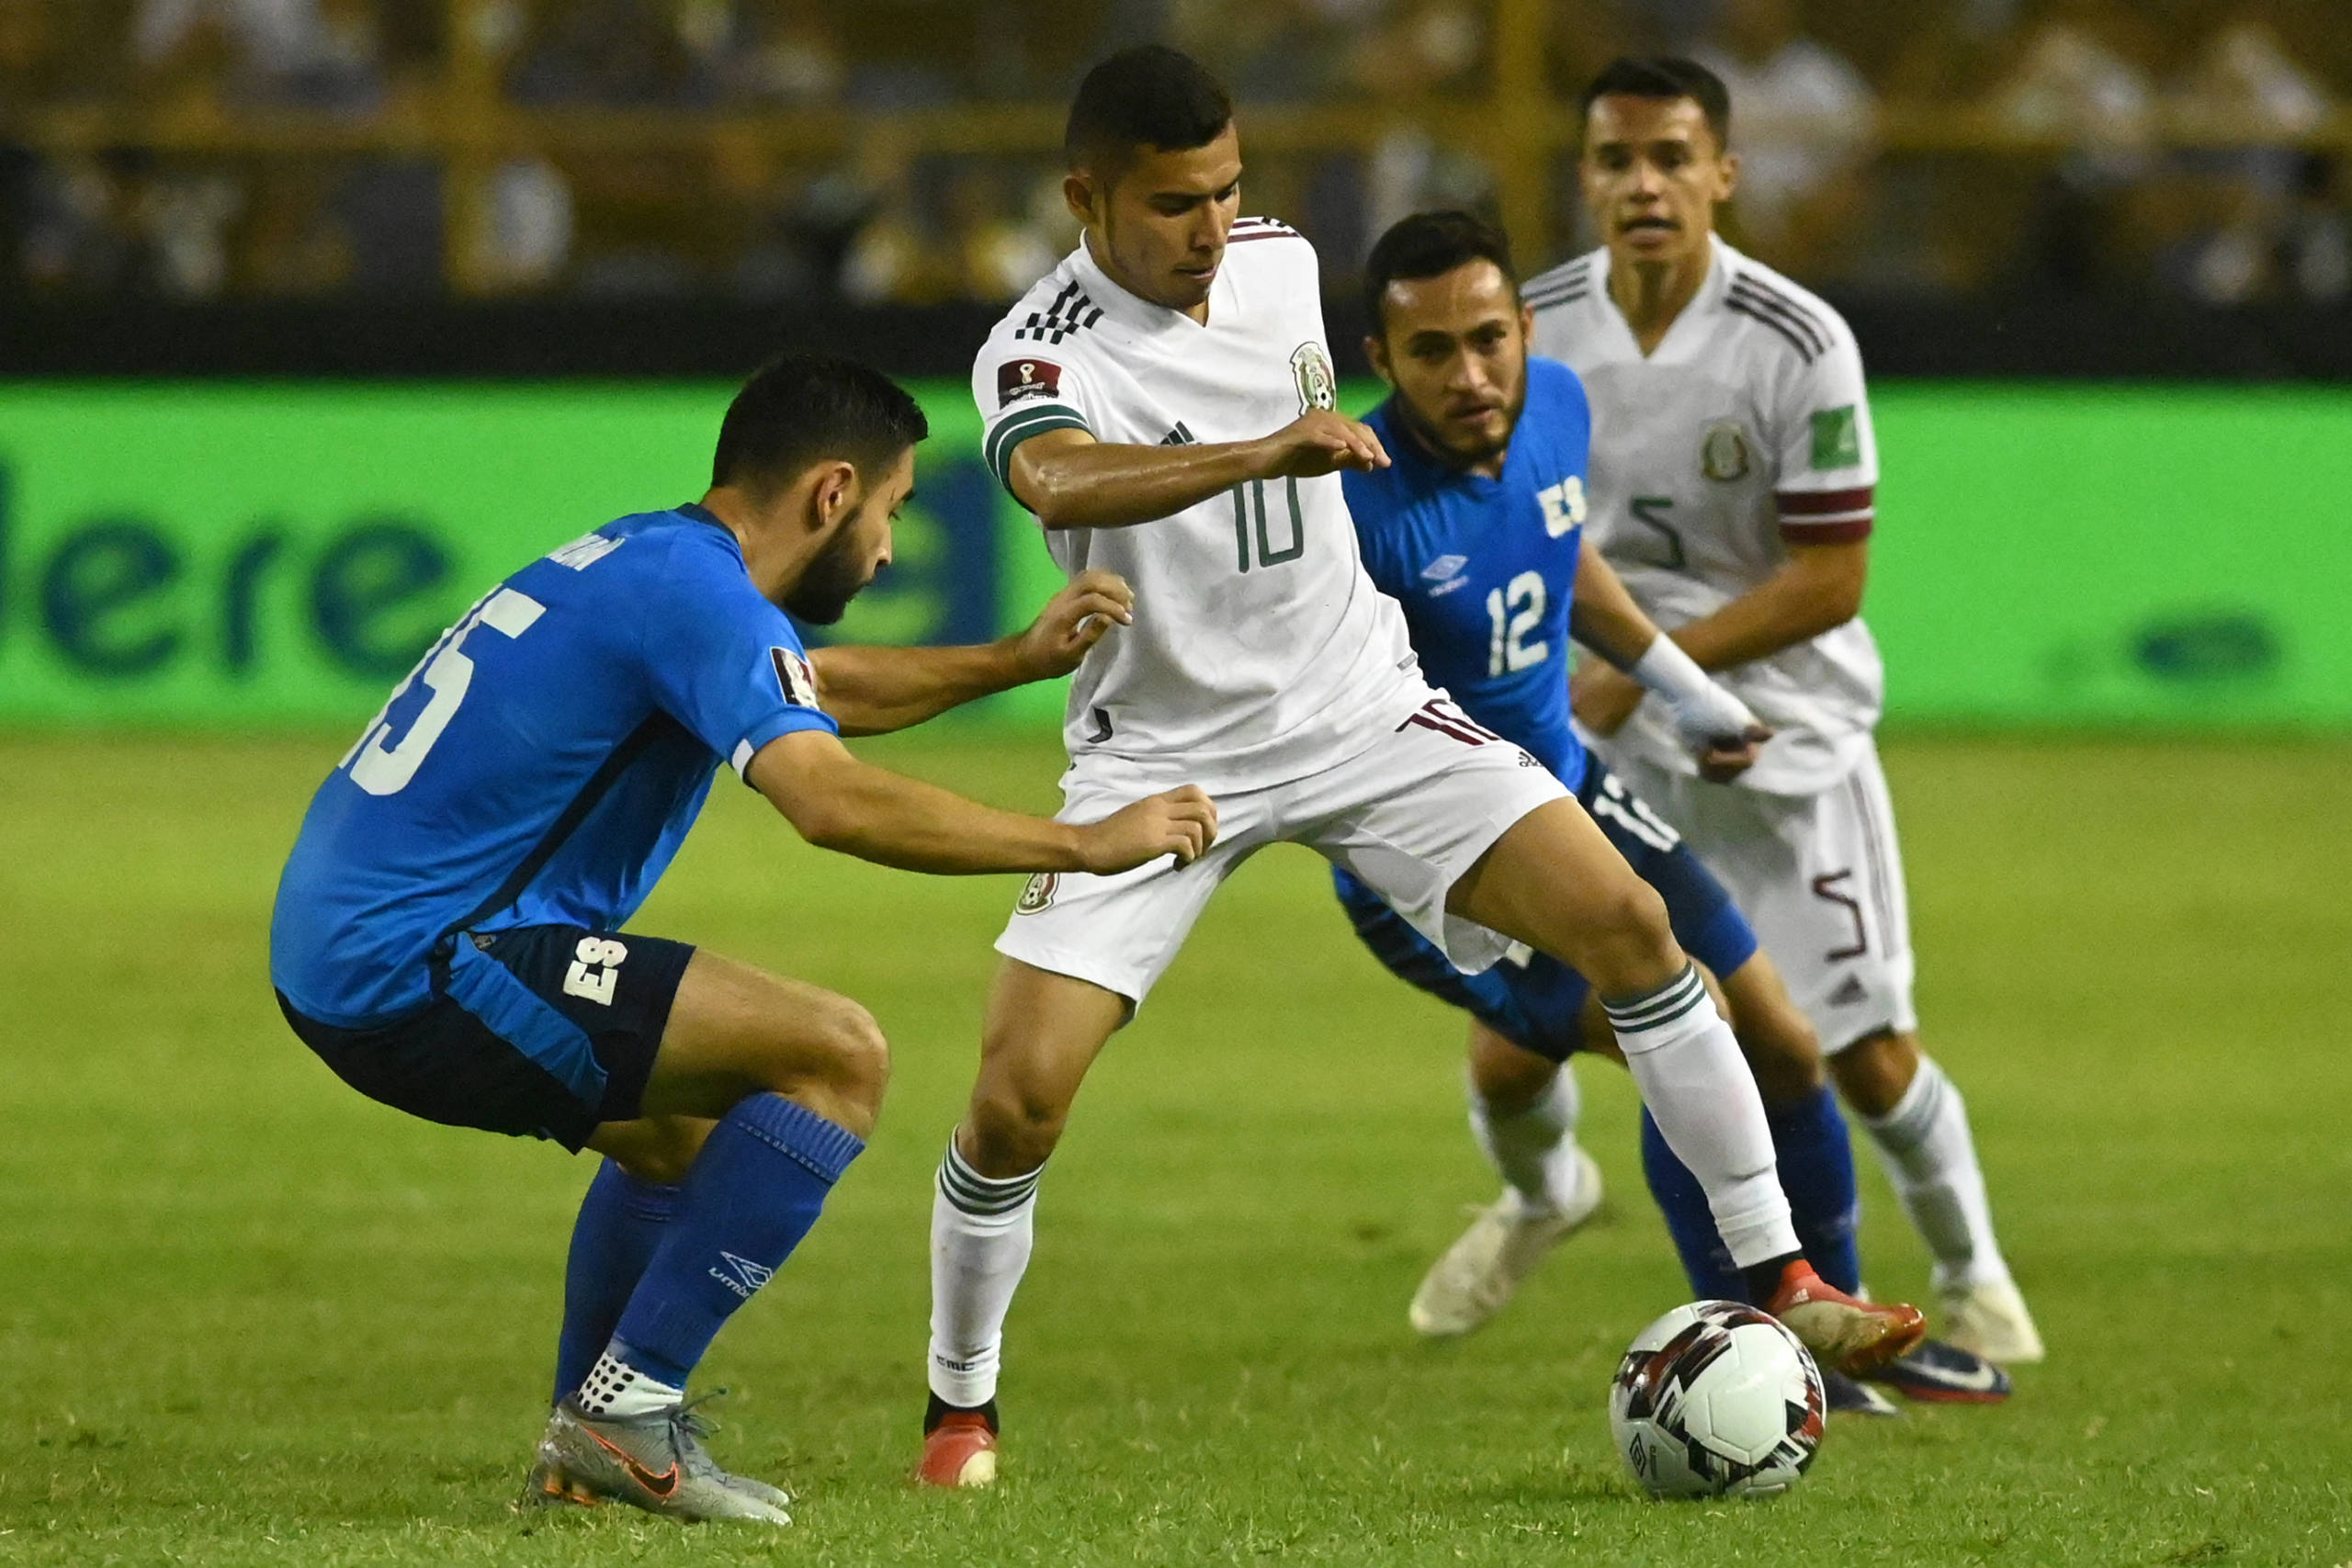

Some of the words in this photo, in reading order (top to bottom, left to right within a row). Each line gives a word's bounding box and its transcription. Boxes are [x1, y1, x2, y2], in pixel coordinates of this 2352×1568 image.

[1232, 474, 1305, 574] 10
[1629, 497, 1686, 571] 5
[1486, 570, 1549, 678] 12
[339, 583, 547, 796] 5
[1813, 867, 1867, 964] 5
